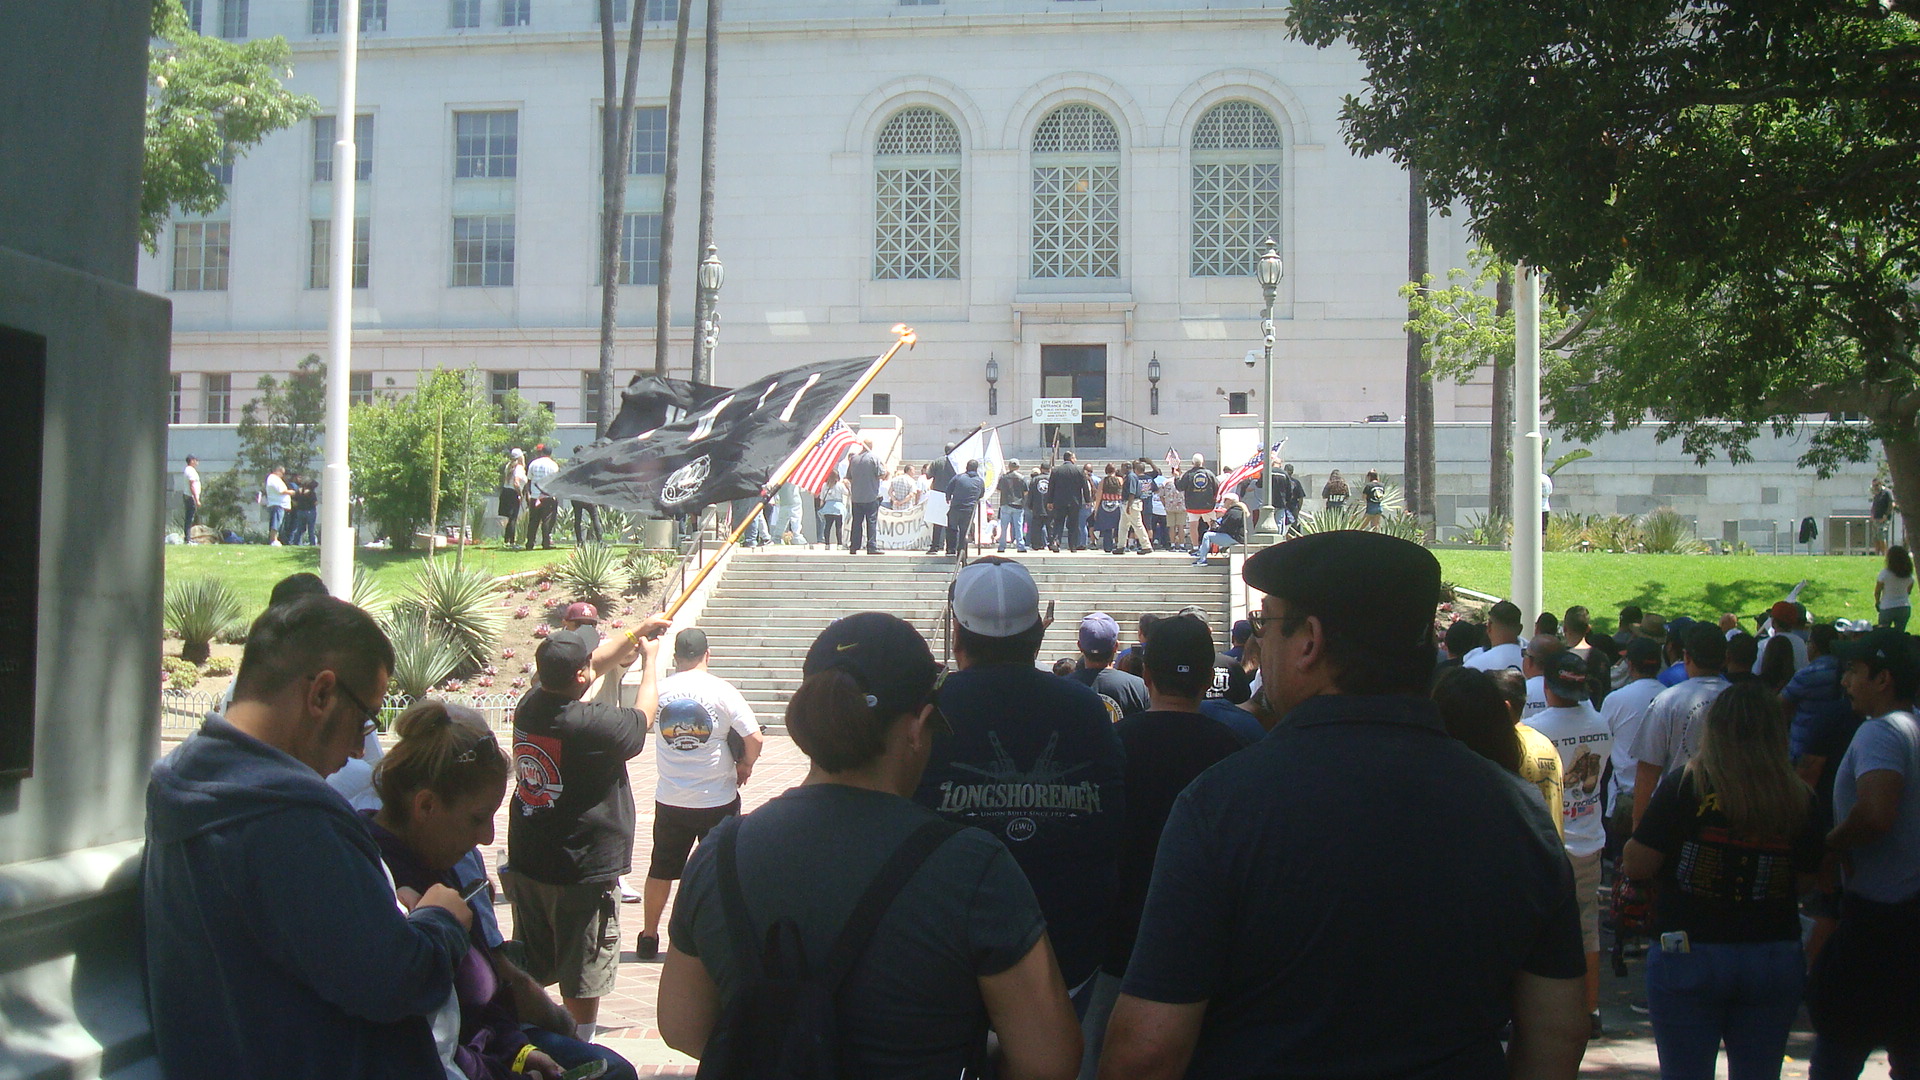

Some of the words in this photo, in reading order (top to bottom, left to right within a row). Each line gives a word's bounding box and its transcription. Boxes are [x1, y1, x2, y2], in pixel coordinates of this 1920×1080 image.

[1562, 736, 1576, 746] TO
[1580, 733, 1609, 744] BOOTS
[1534, 757, 1556, 771] VANS
[937, 780, 1103, 814] LONGSHOREMEN
[1010, 823, 1032, 832] ILWU
